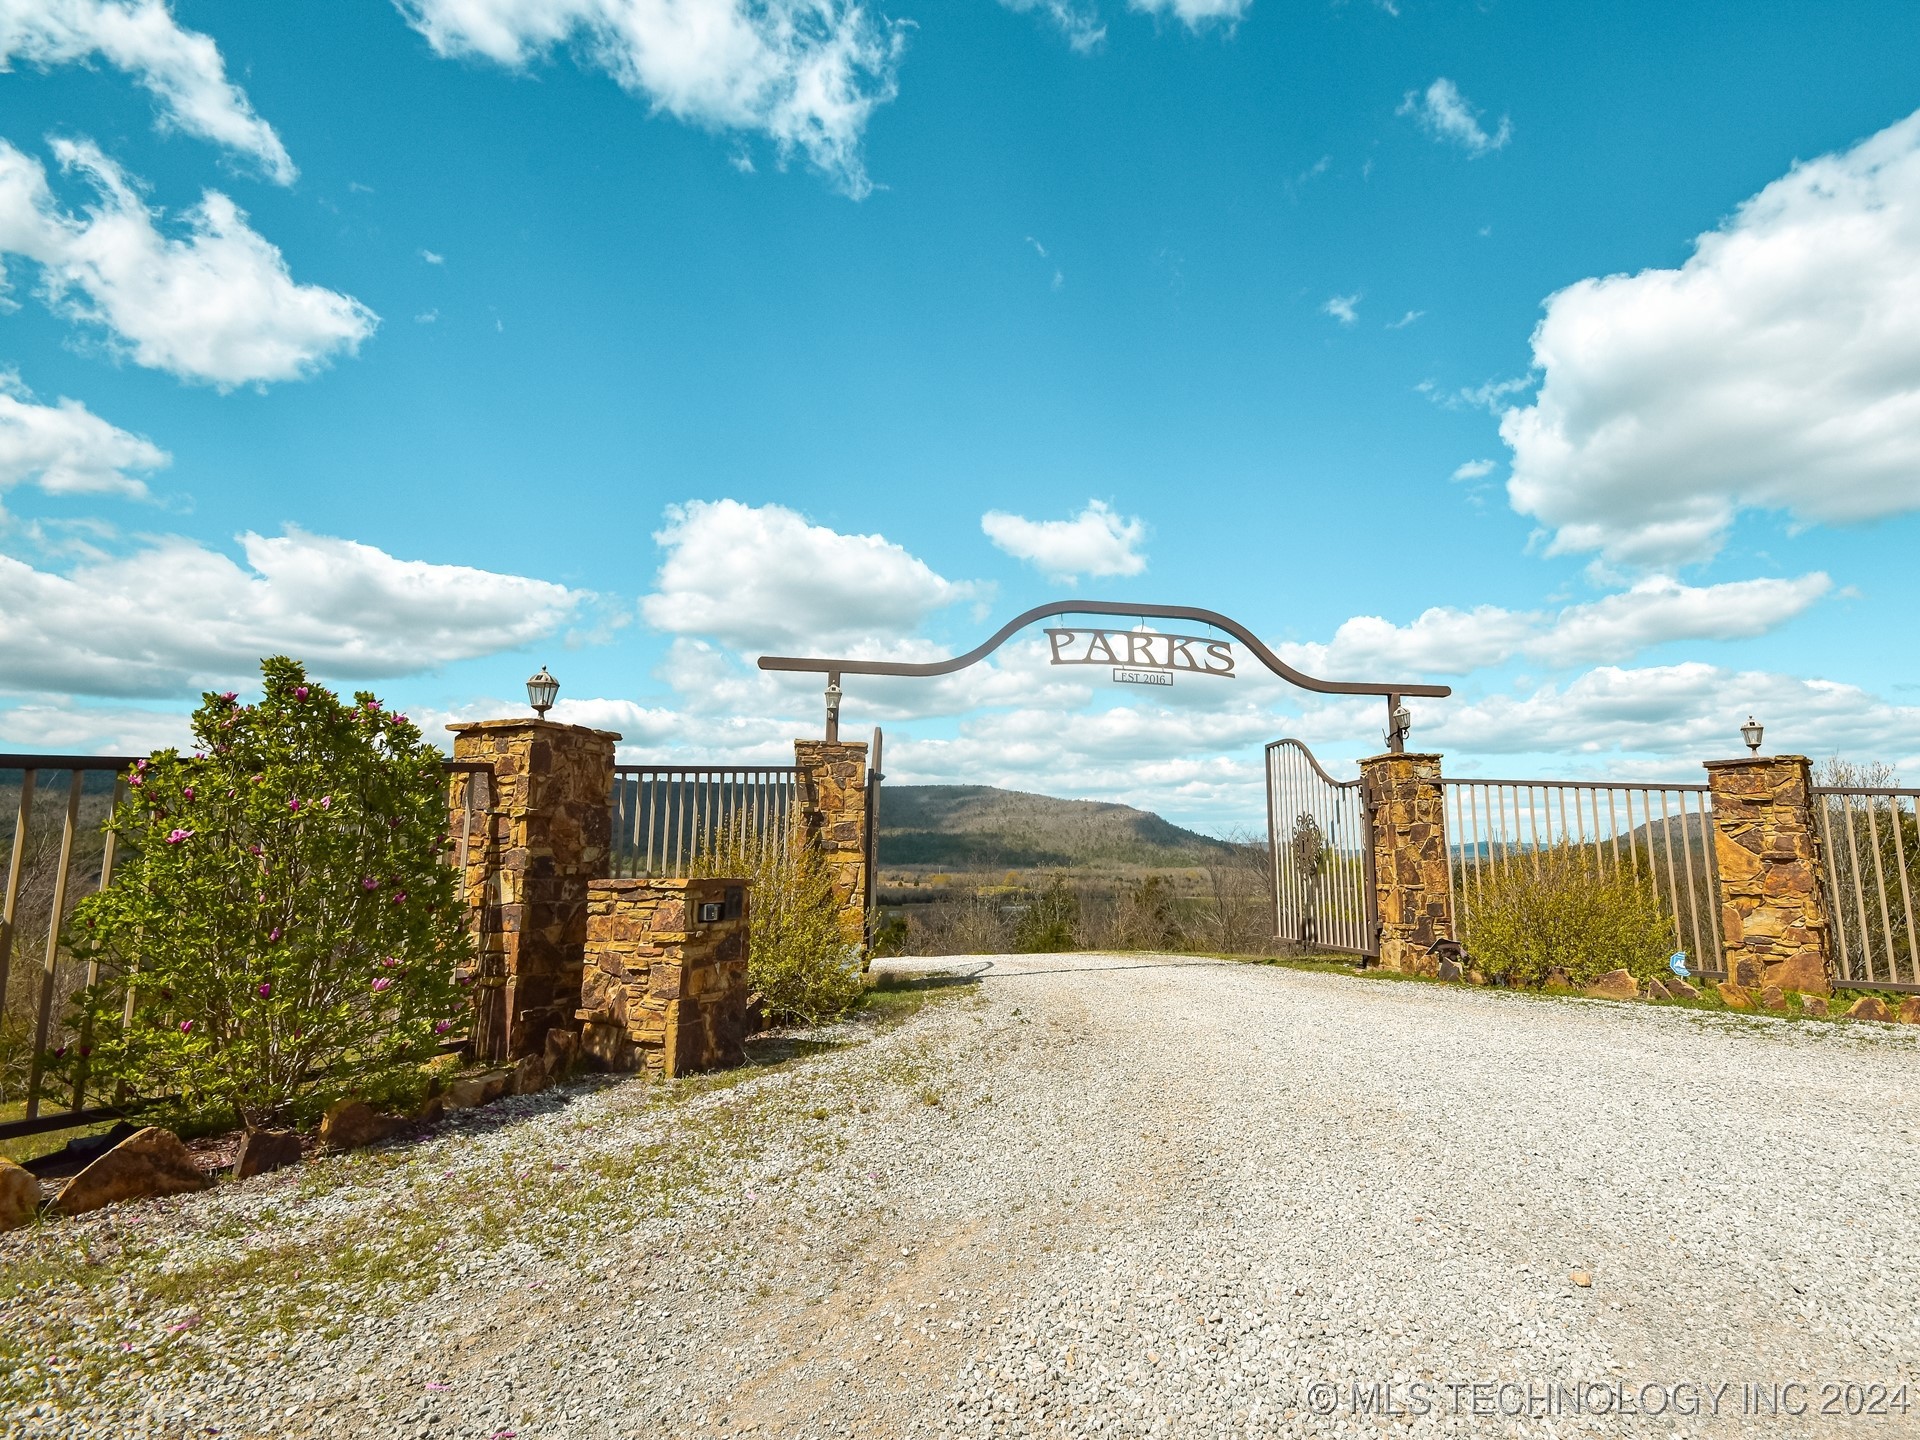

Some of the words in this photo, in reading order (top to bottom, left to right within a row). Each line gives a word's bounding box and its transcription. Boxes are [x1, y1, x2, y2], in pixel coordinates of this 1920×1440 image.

[1043, 628, 1236, 678] PARKS
[1121, 672, 1140, 683] EST
[1143, 673, 1166, 685] 2016
